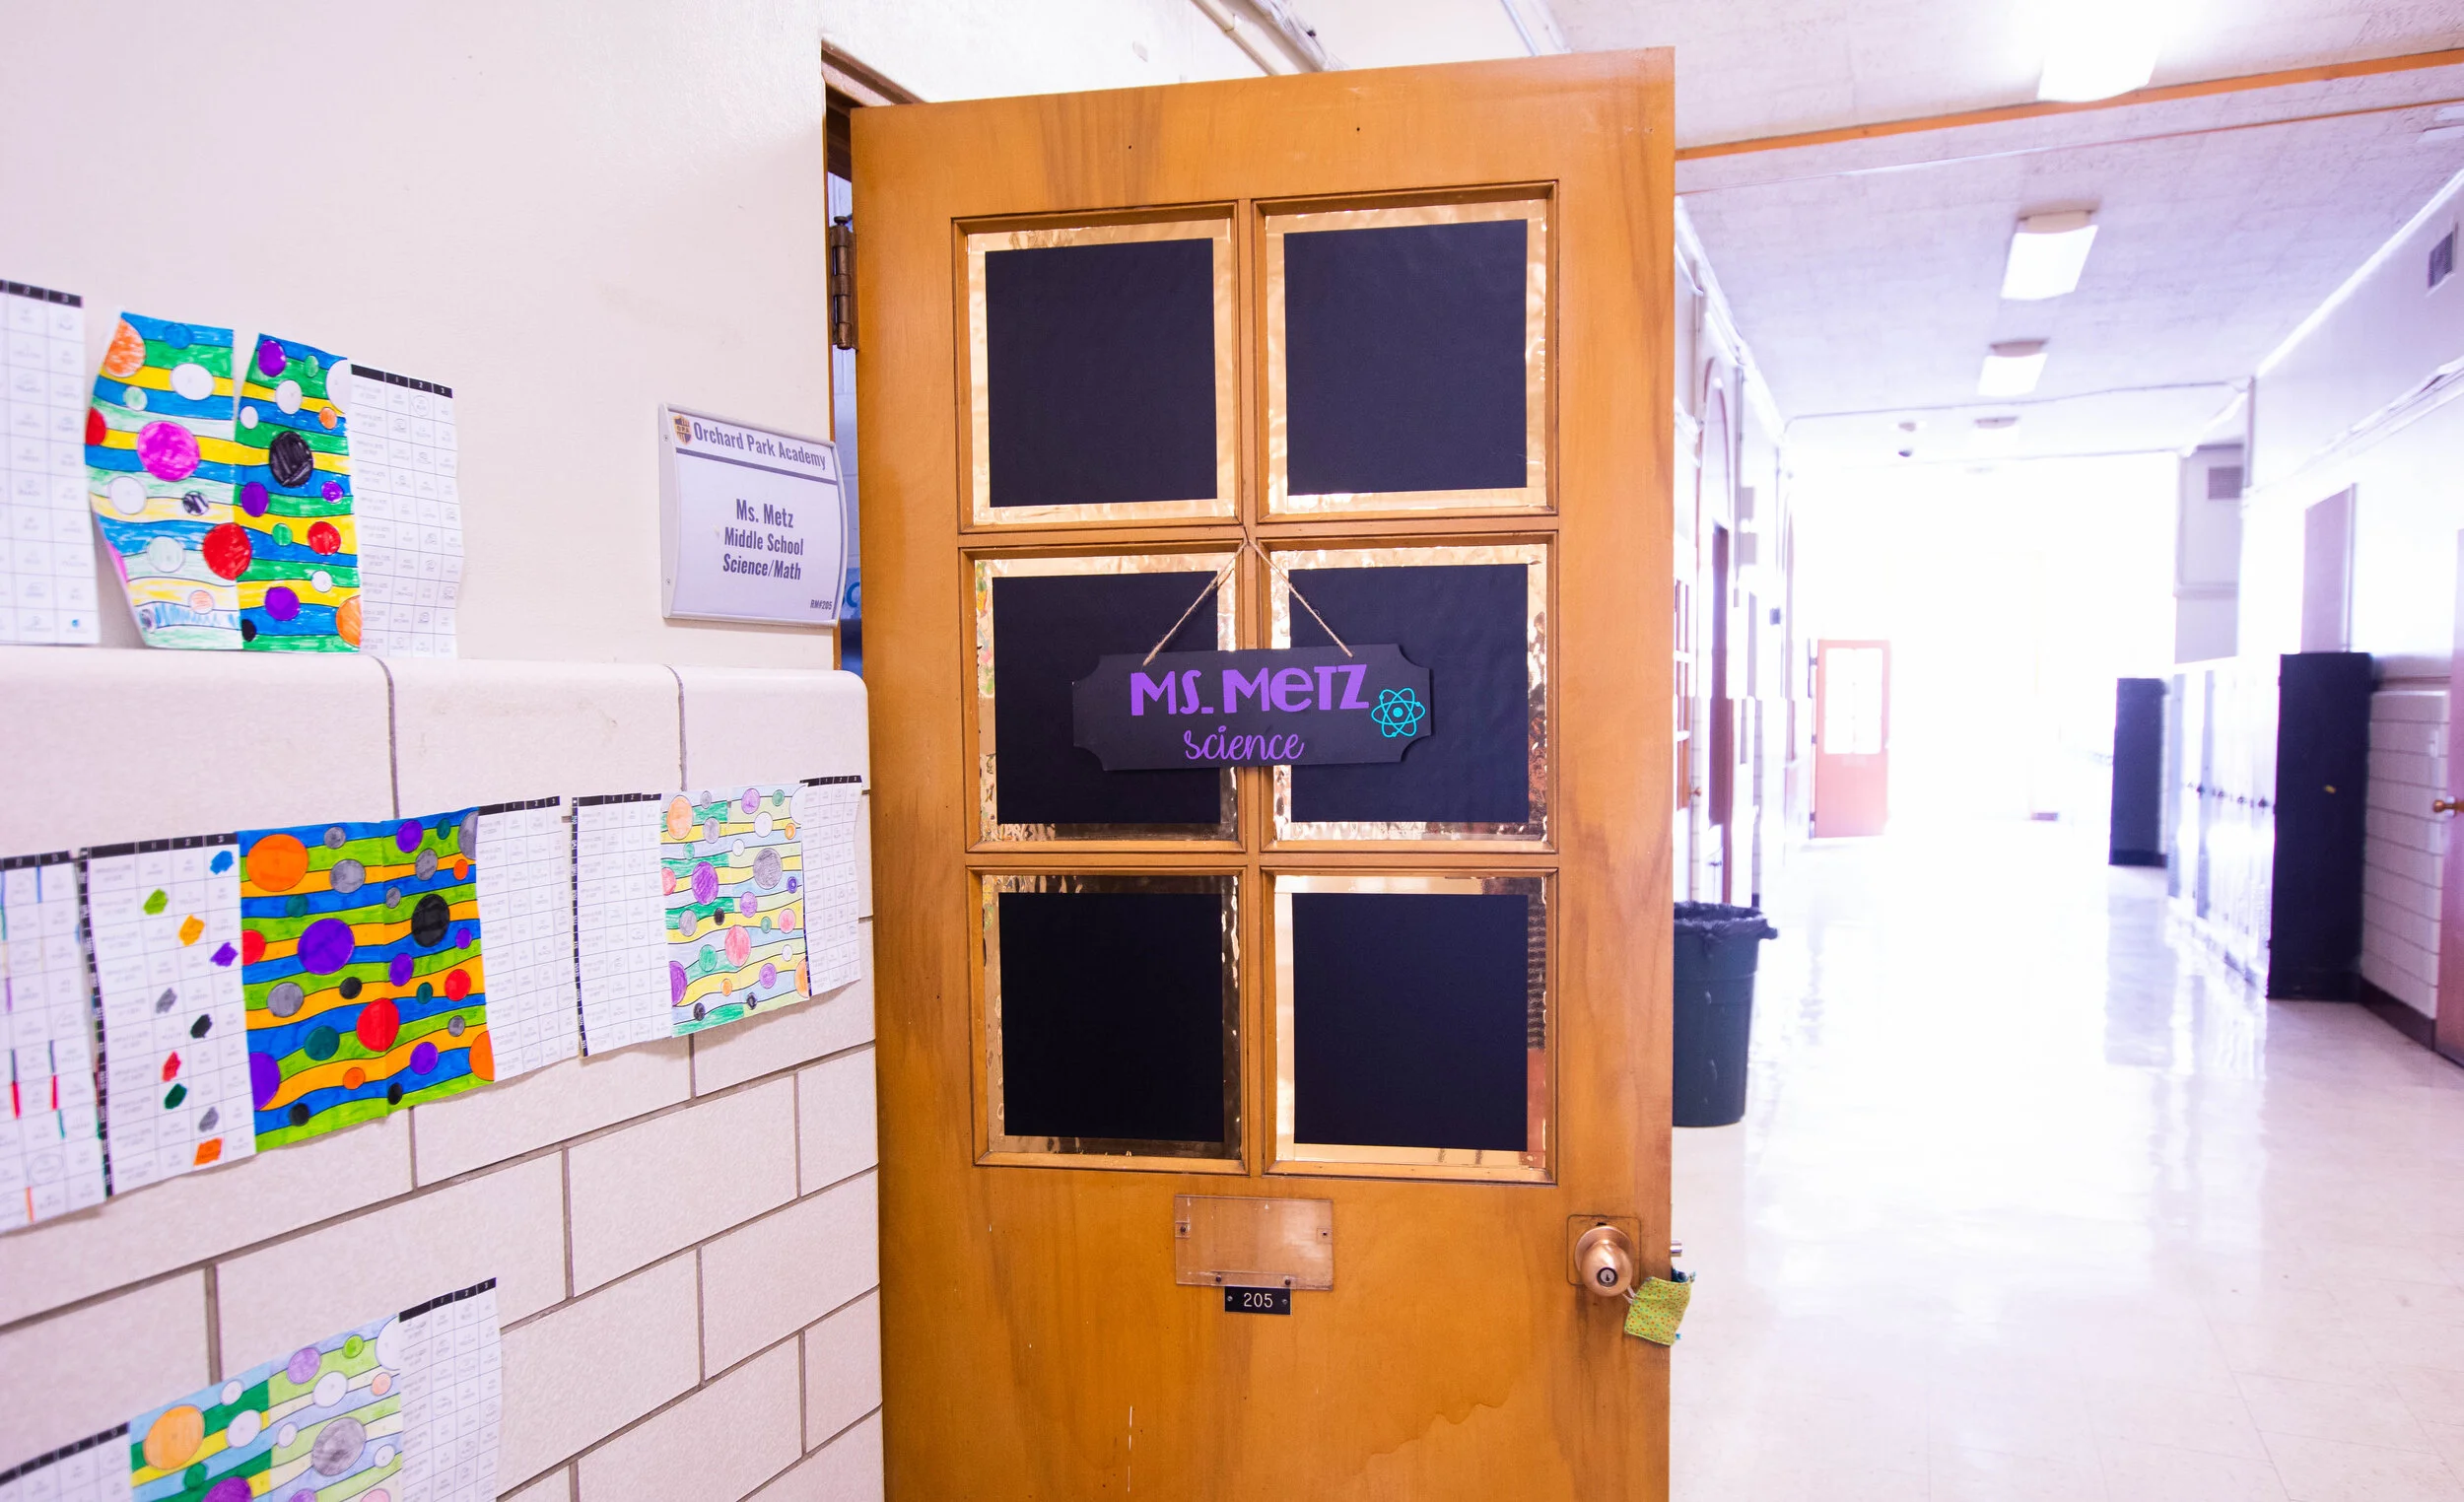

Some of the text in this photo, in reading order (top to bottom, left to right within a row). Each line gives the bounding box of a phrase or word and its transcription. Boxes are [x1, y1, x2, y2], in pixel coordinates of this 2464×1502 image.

[693, 422, 827, 471] Orchard Park Academy
[735, 498, 794, 529] Ms. Metz
[724, 526, 804, 556] Middle School
[722, 553, 801, 580] Science/Math
[810, 599, 833, 611] RM#205
[1183, 724, 1305, 761] science
[1243, 1292, 1273, 1309] 205
